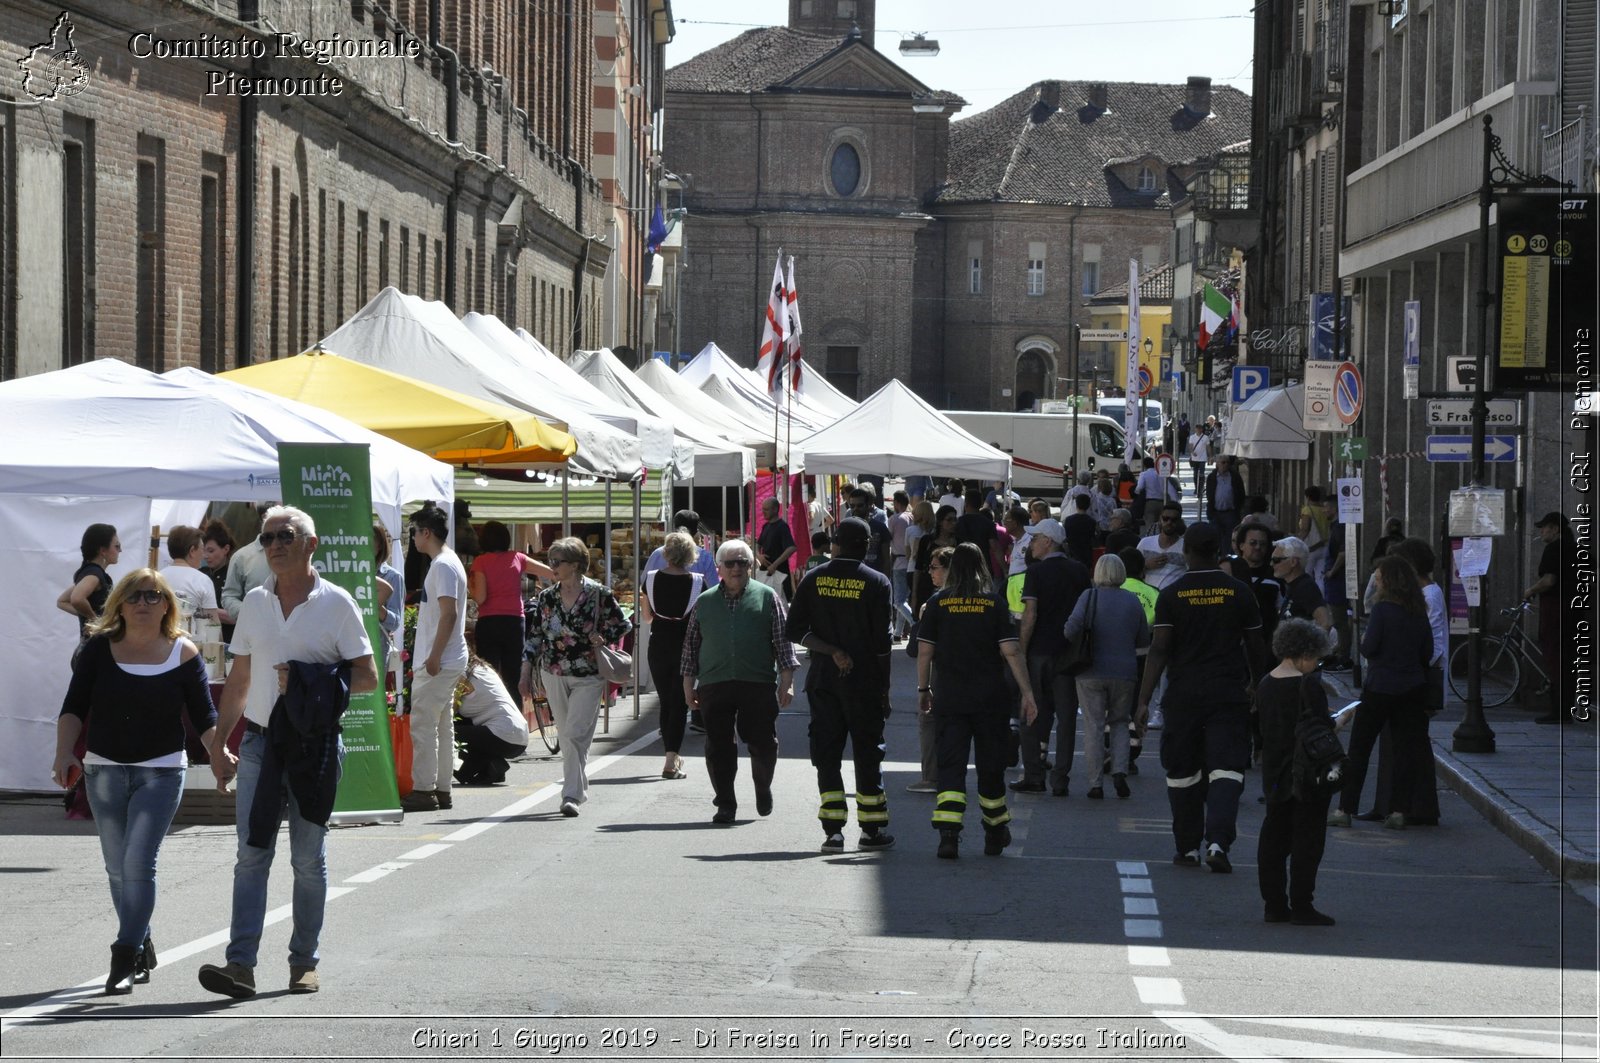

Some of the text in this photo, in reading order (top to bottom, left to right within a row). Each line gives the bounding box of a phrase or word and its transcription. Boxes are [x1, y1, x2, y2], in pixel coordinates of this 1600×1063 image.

[1562, 199, 1588, 211] GTT
[1512, 236, 1547, 249] 1 30
[1240, 370, 1263, 400] P
[1431, 412, 1513, 422] S. Fraesco
[815, 576, 866, 590] GUARDIE AI FUOCHI
[818, 588, 860, 599] VOLONTARIE
[1212, 588, 1235, 596] FUOCHI
[939, 598, 964, 606] GUARDIE
[973, 598, 995, 607] FUOCHI
[948, 605, 985, 613] VOLONTARIE
